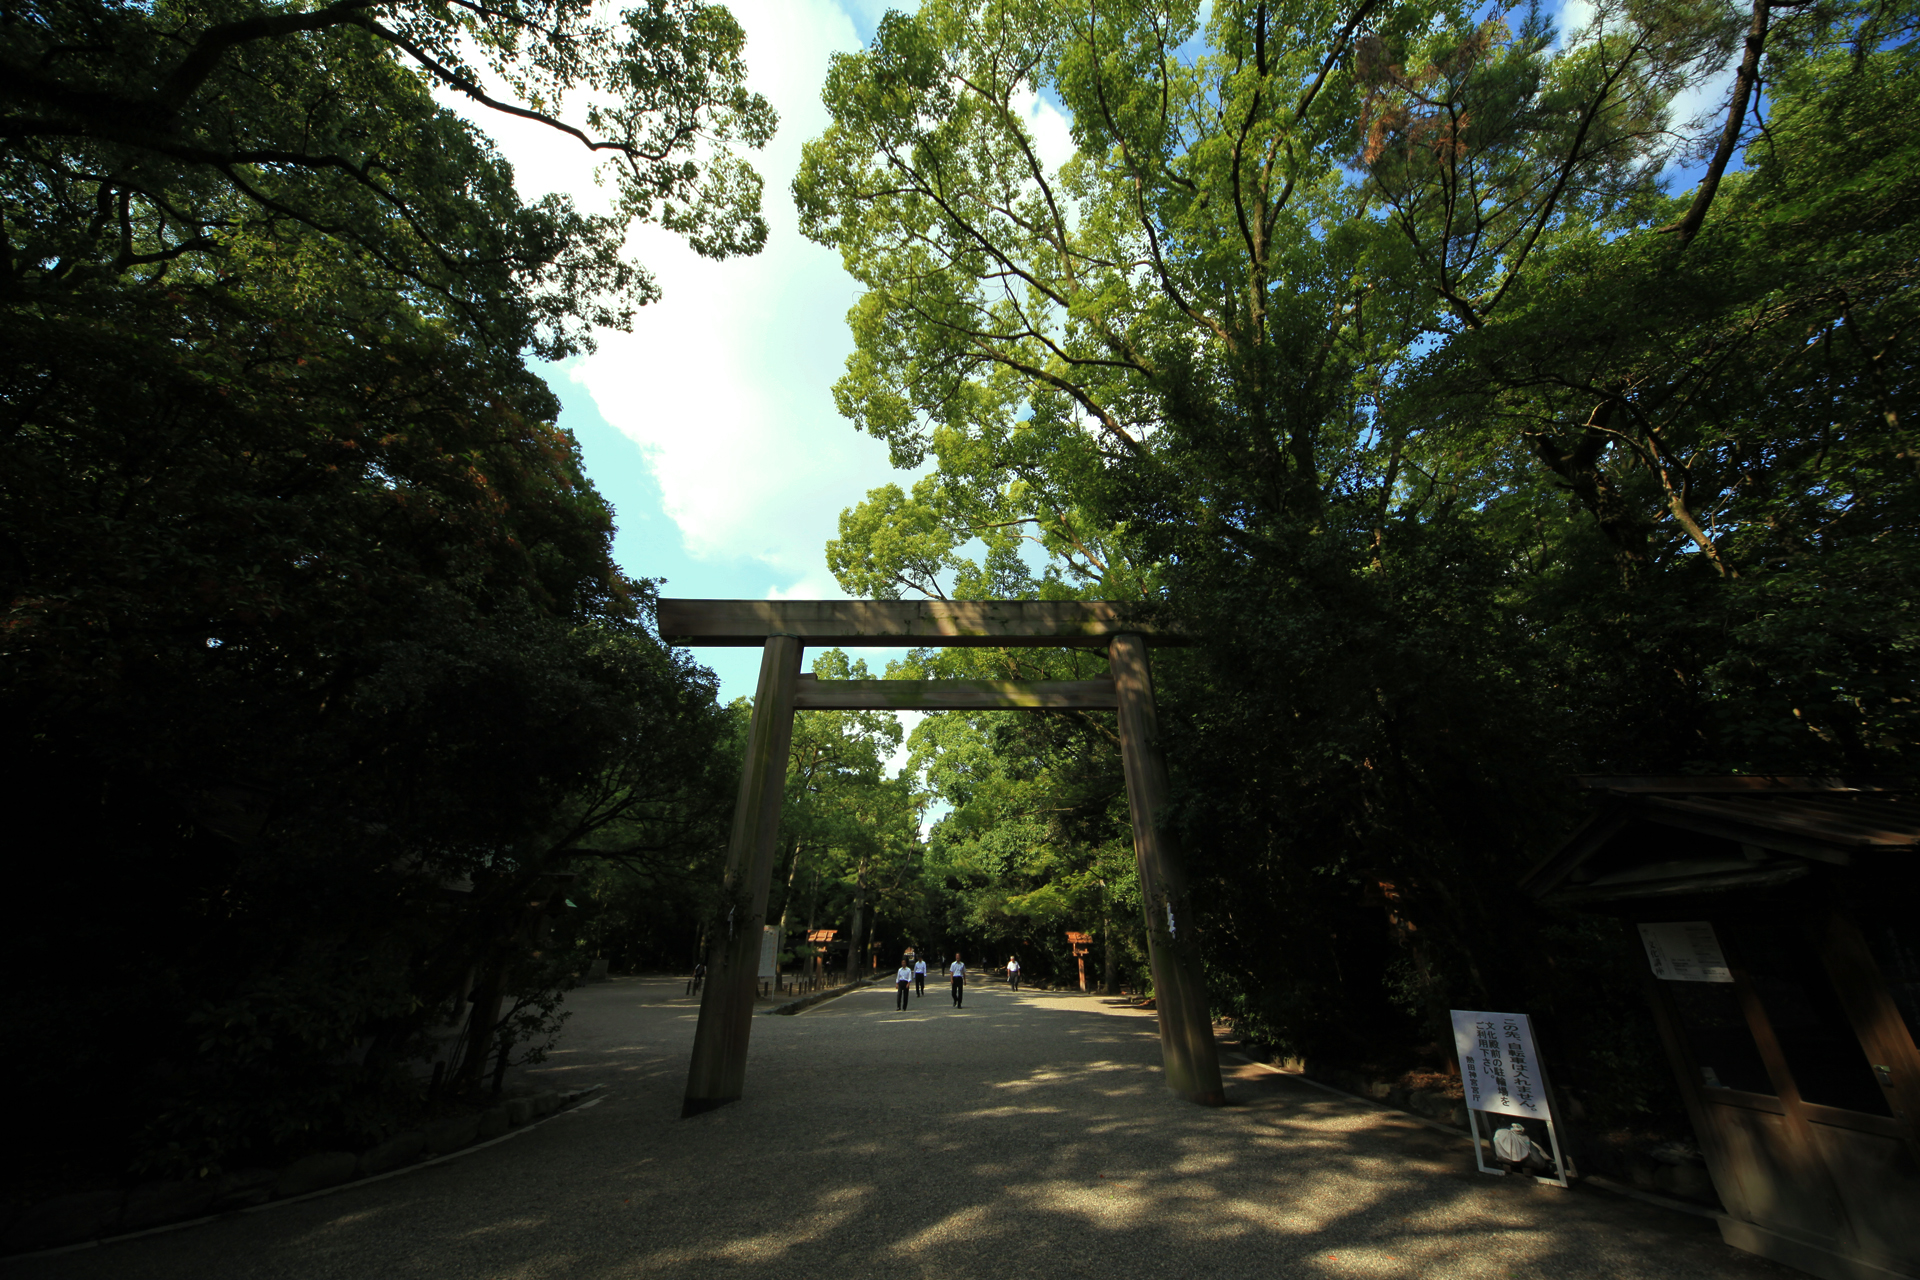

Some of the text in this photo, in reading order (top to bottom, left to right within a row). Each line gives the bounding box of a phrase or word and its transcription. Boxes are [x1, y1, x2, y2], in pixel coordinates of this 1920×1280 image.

[1476, 1021, 1495, 1079] ご利用下さい。
[1486, 1021, 1509, 1106] 文化殿前の駐輪場を
[1503, 1018, 1537, 1111] この先、自転車は入れません。
